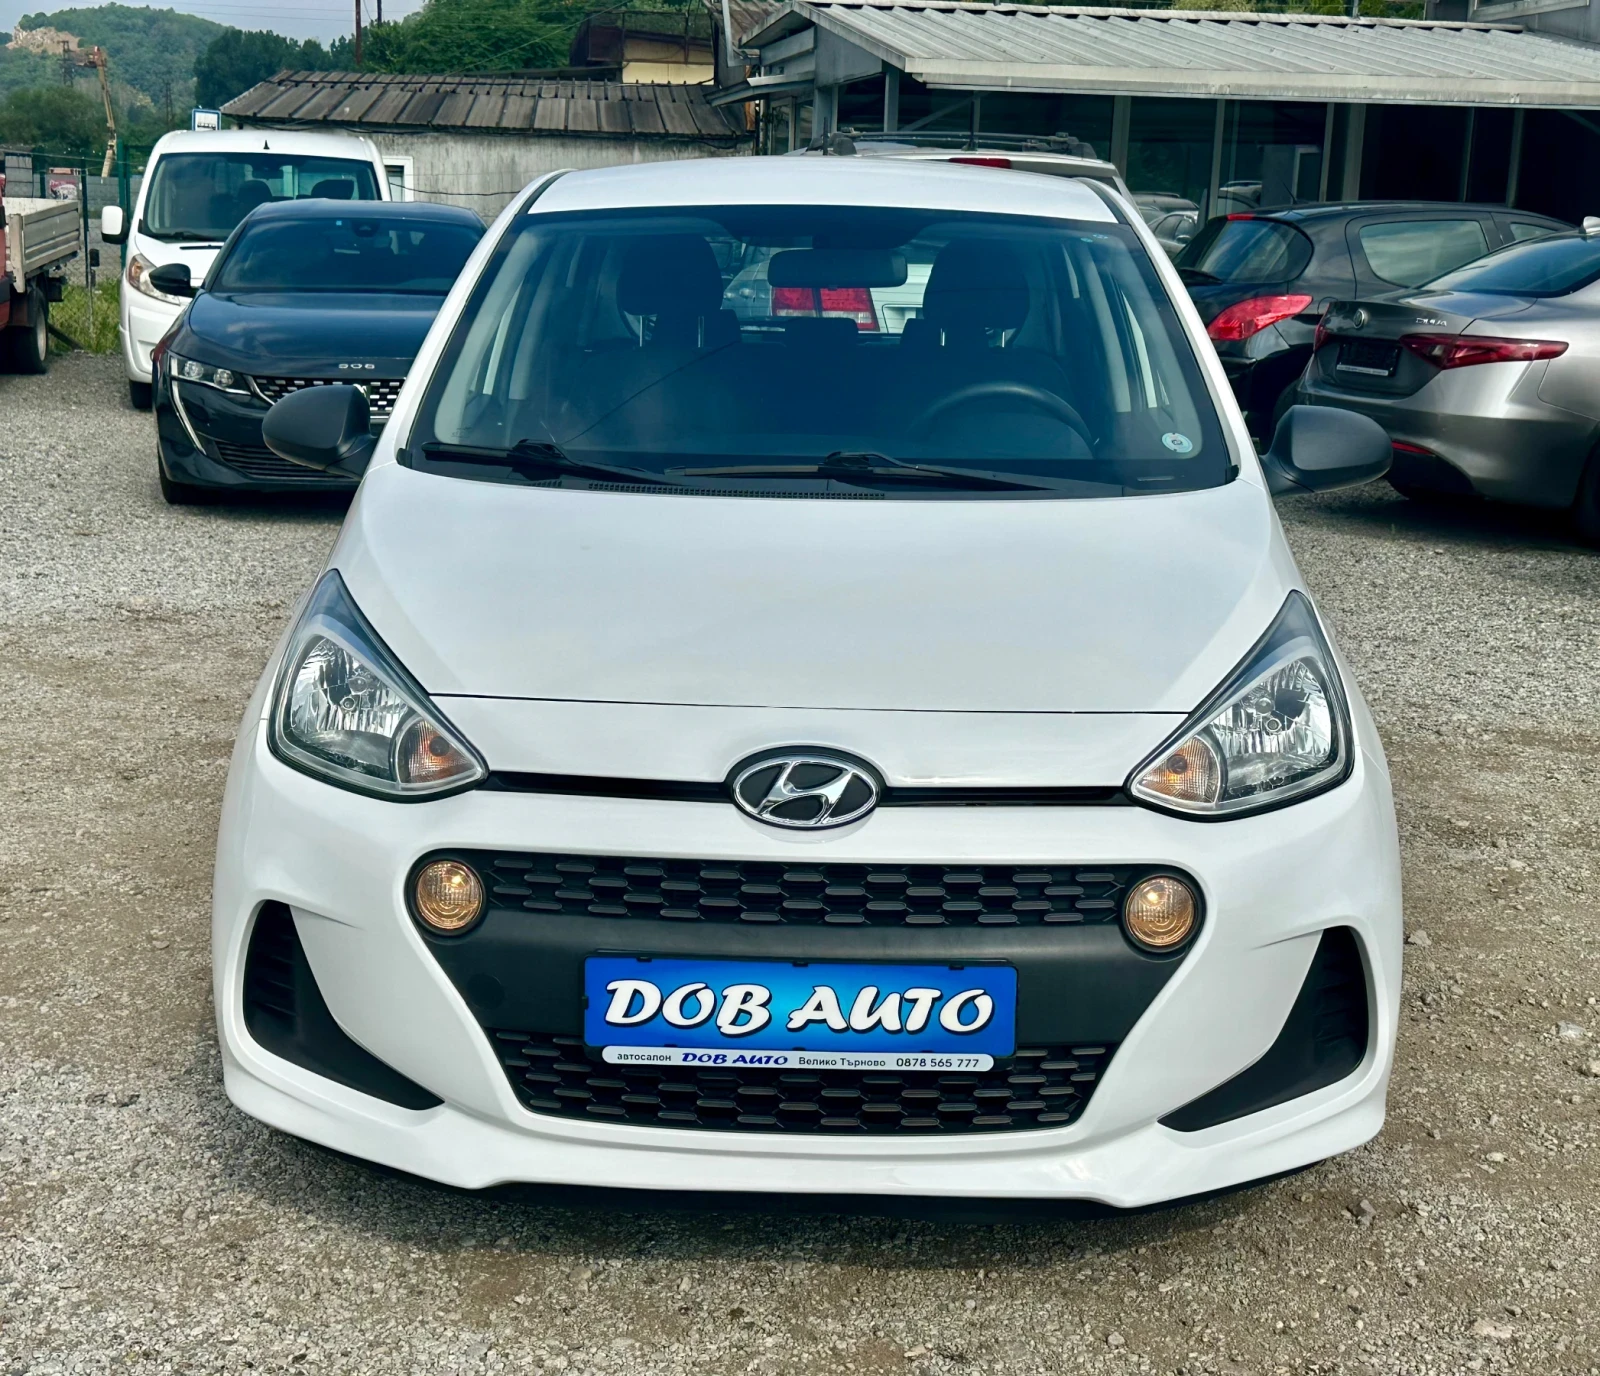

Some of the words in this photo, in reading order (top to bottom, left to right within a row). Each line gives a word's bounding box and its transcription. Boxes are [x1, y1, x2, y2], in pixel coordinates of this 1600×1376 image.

[605, 979, 771, 1036] DOB
[787, 985, 996, 1034] AUTO
[616, 1052, 672, 1062] автосалон
[681, 1052, 728, 1065] DOB
[732, 1054, 789, 1066] AUTO
[798, 1056, 837, 1066] Велико
[840, 1057, 886, 1068] Търново
[896, 1057, 927, 1068] 0878
[930, 1058, 953, 1068] 565
[957, 1058, 980, 1069] 777
